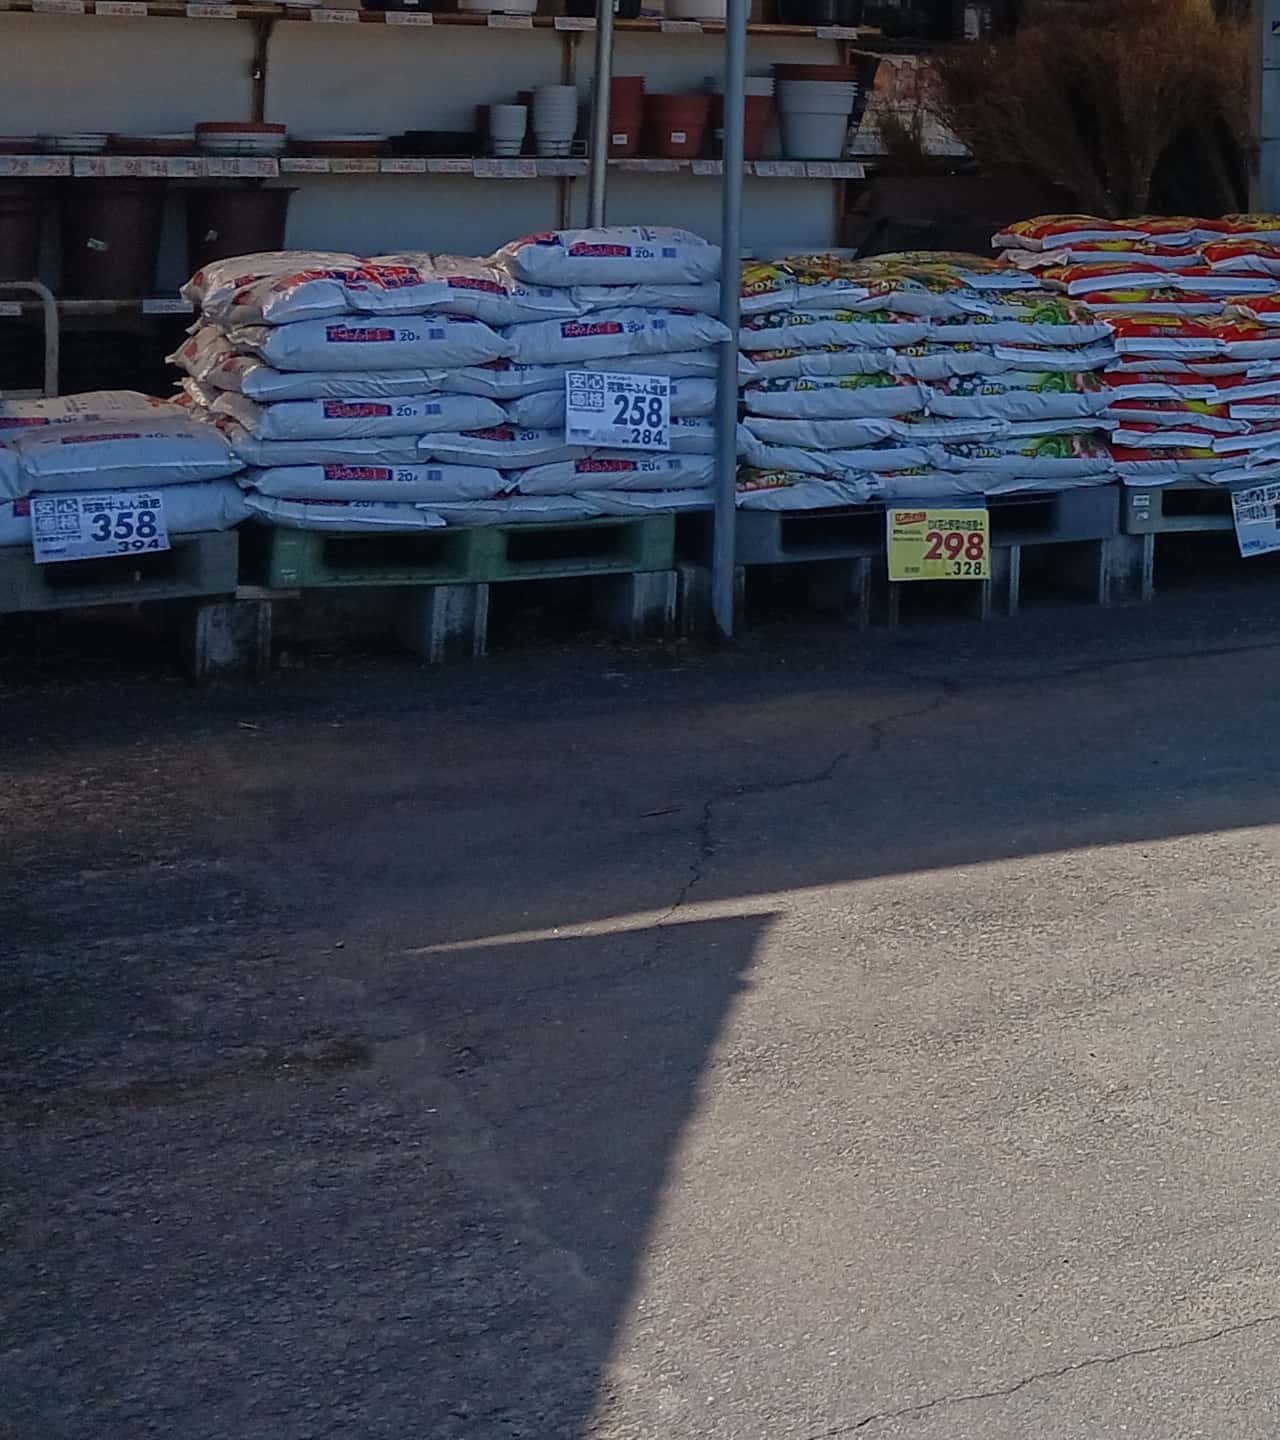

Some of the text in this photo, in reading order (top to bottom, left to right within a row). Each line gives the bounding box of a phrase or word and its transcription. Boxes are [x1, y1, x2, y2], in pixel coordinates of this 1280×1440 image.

[612, 394, 663, 428] 258
[631, 428, 664, 445] 284
[91, 510, 157, 542] 358
[924, 531, 984, 561] 298
[953, 561, 982, 576] 328
